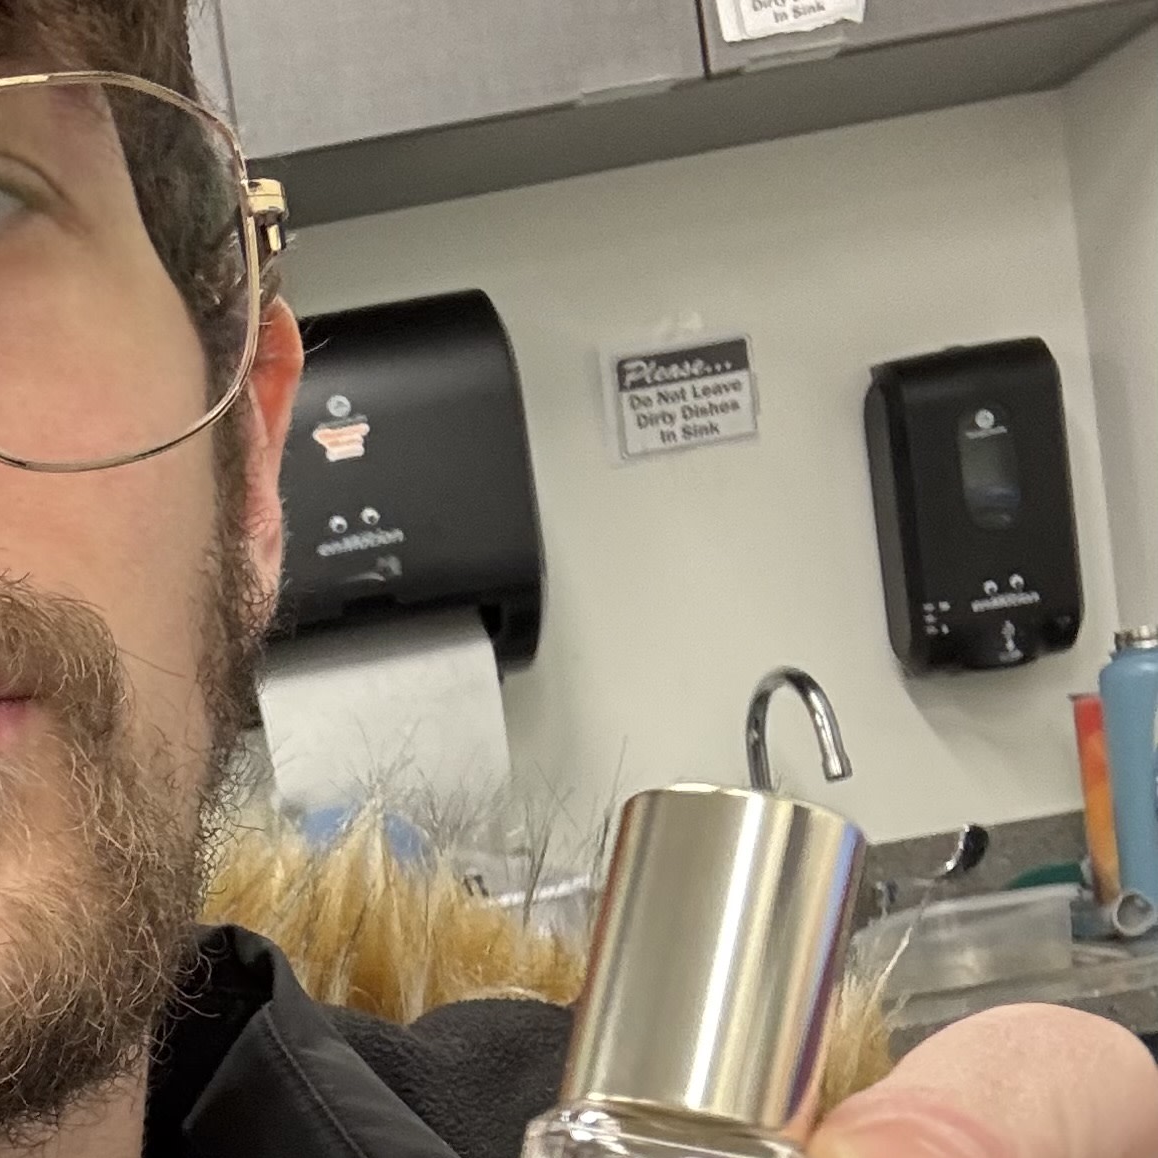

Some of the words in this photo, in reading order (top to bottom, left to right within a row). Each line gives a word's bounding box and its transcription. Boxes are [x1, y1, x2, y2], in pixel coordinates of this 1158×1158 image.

[793, 2, 826, 19] Sink
[628, 394, 653, 411] Do
[656, 387, 687, 406] Not
[691, 379, 742, 399] Leave
[636, 410, 676, 430] Dirty
[681, 399, 741, 421] Dishes
[660, 429, 677, 444] In
[681, 421, 720, 441] Sink
